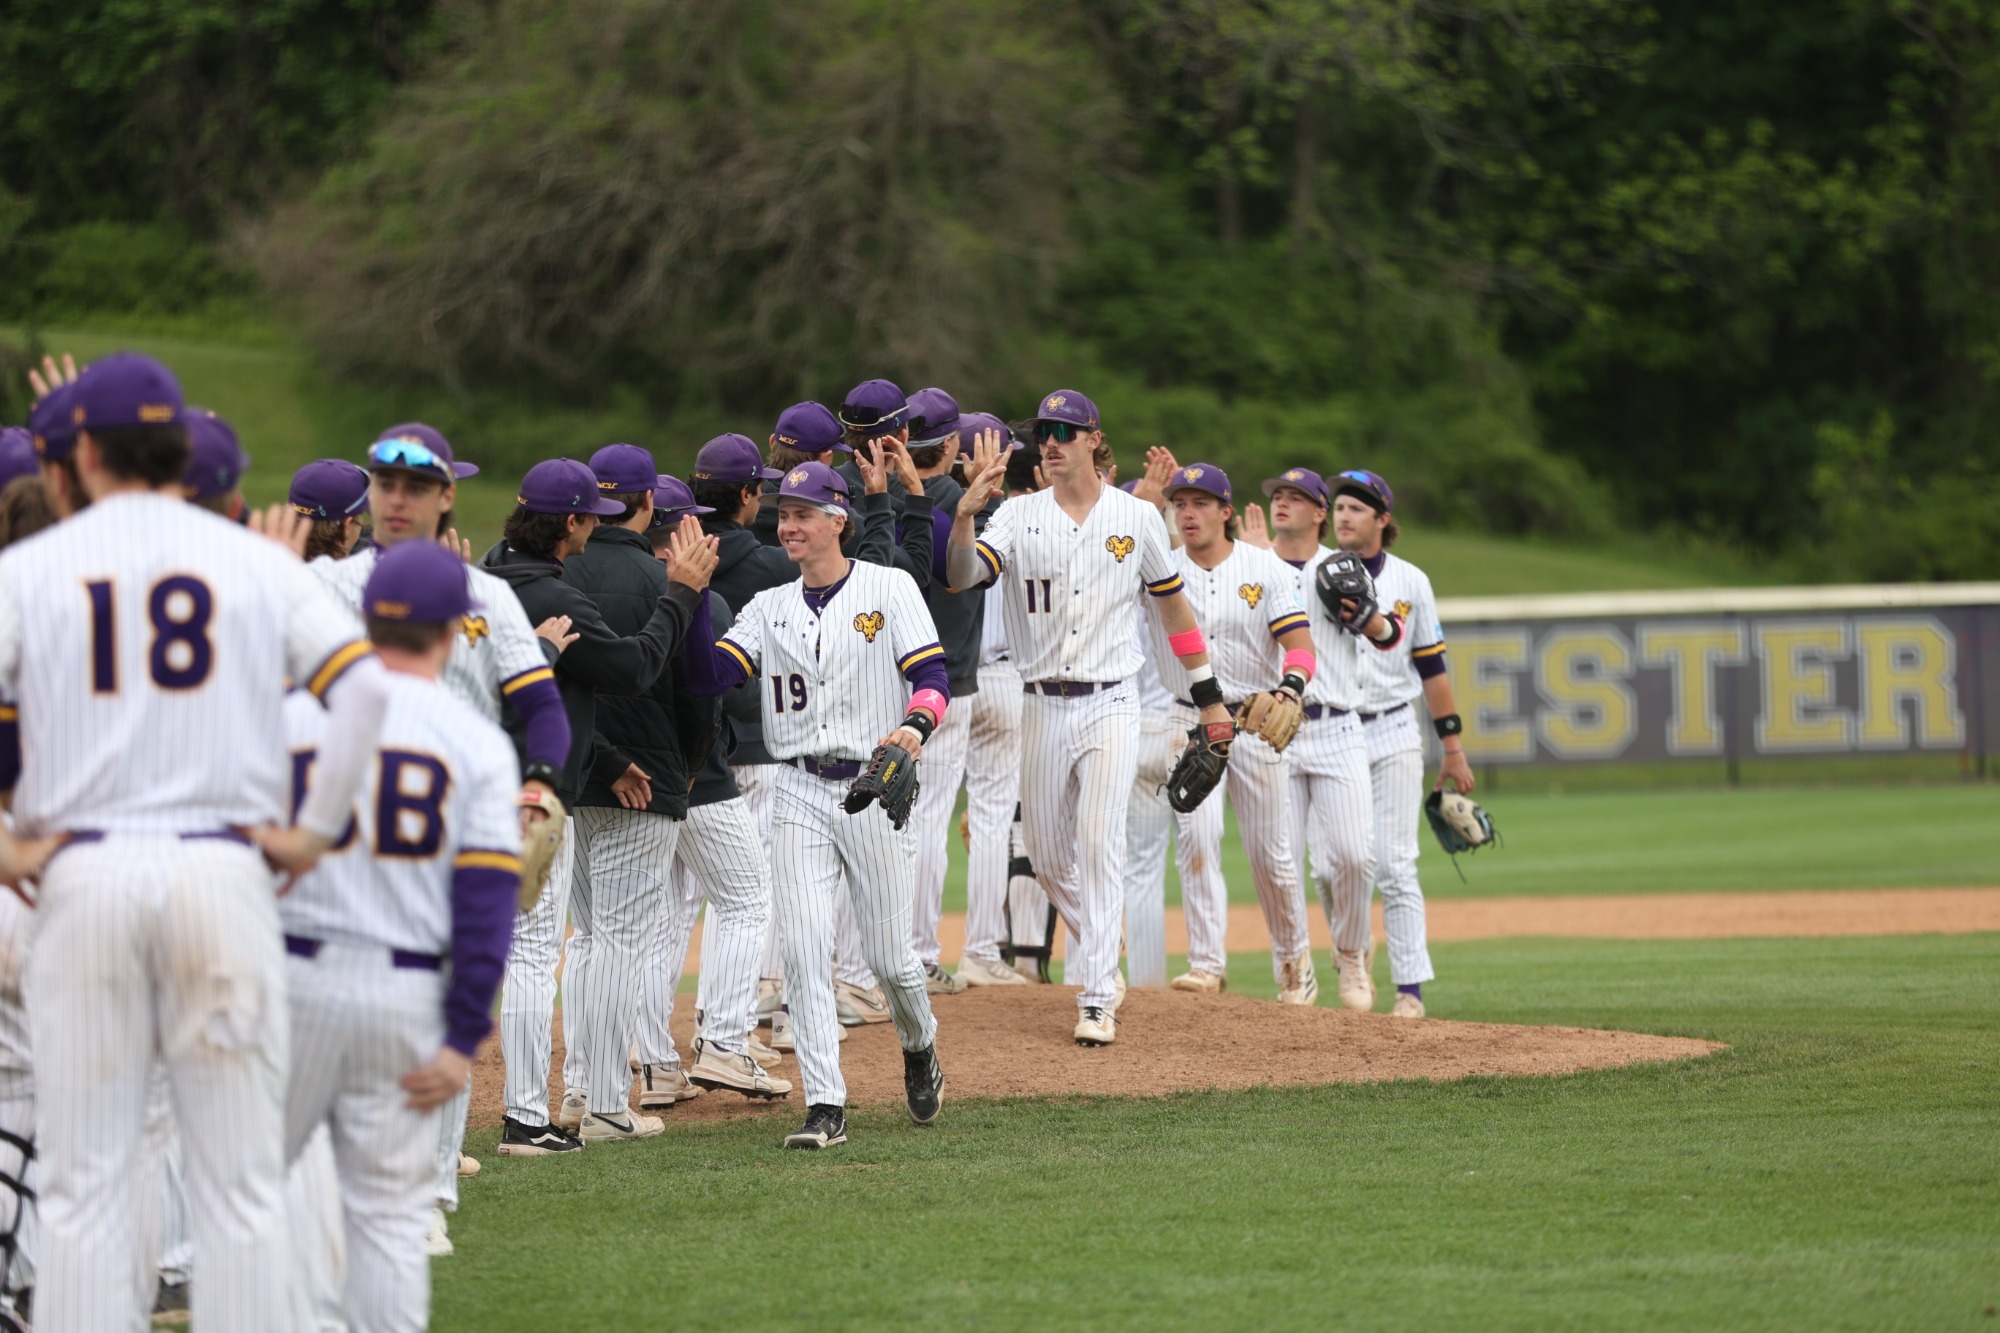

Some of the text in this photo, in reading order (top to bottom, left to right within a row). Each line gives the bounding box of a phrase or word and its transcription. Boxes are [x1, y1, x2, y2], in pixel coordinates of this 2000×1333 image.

[778, 434, 798, 445] WCU
[596, 482, 619, 490] WCU
[1024, 578, 1052, 615] 11
[80, 571, 215, 694] 18
[769, 672, 808, 714] 19
[1430, 615, 1966, 762] ESTER
[882, 760, 897, 784] A2000
